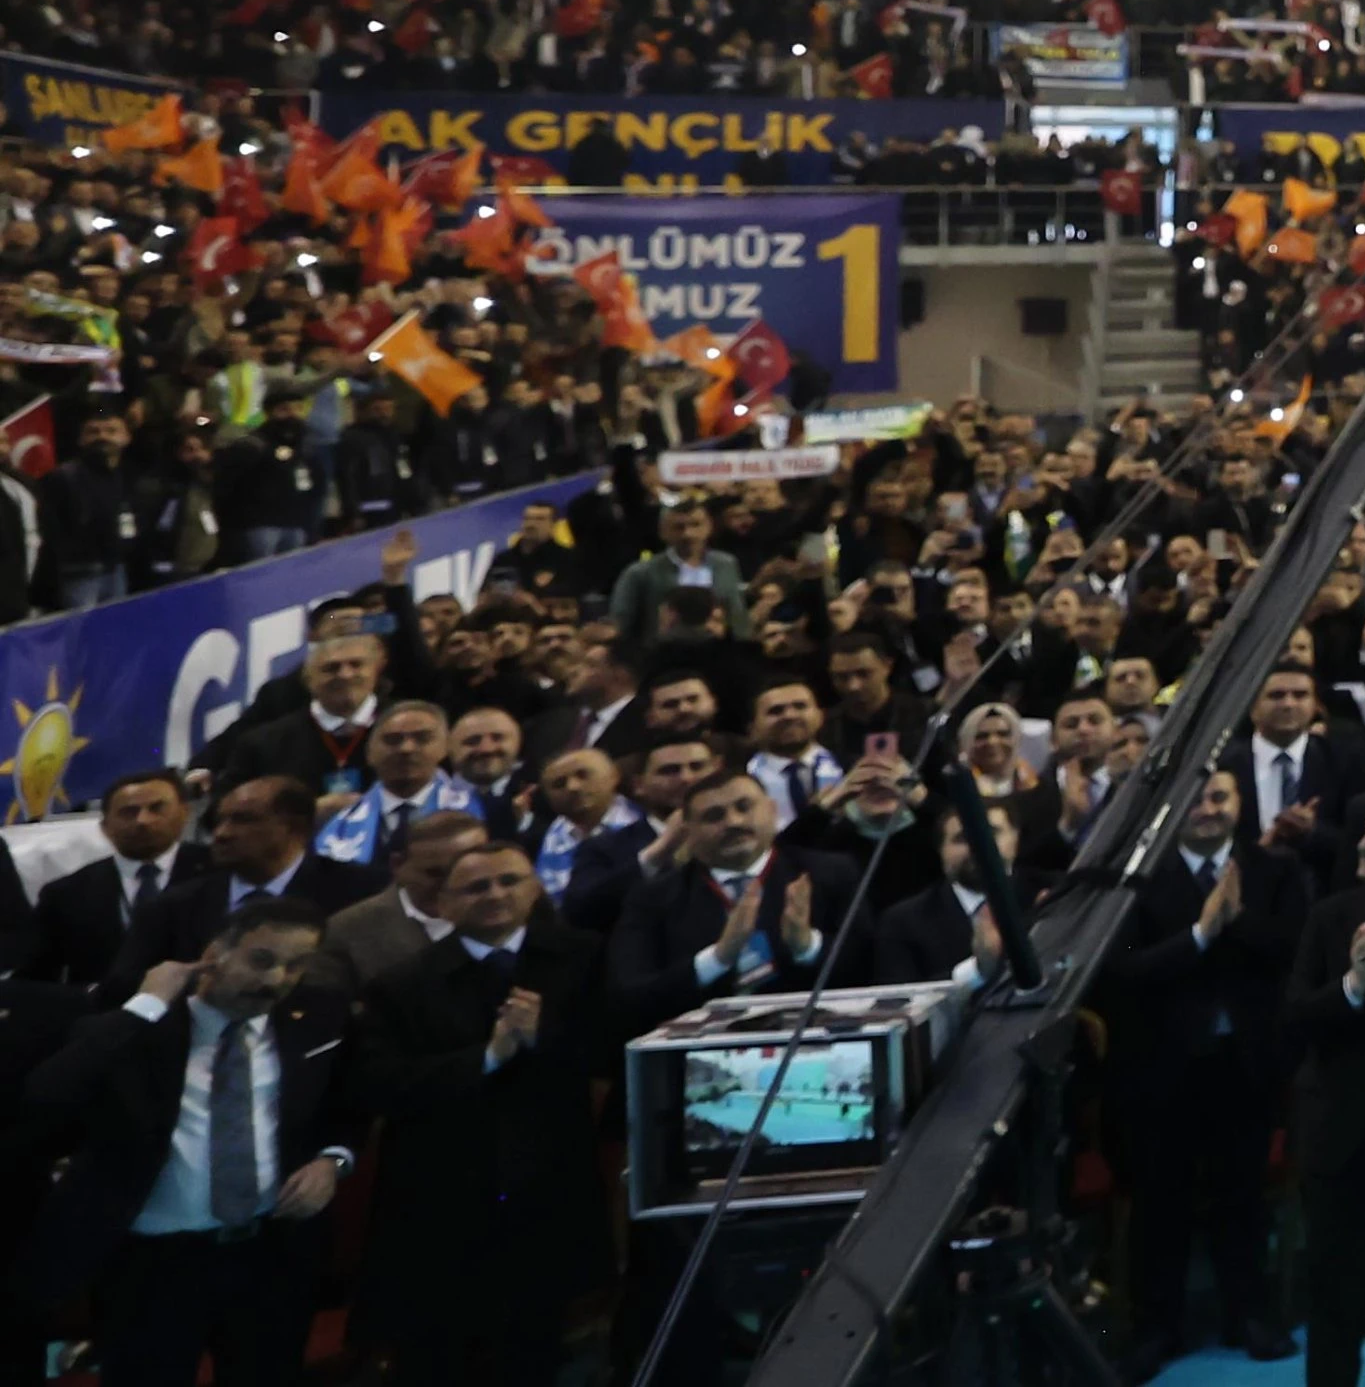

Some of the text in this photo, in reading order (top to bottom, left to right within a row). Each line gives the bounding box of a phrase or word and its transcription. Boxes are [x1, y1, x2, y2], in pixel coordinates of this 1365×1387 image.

[379, 109, 835, 159] AK GENÇLİK
[527, 223, 880, 364] ÖNLÜMÜZ 1
